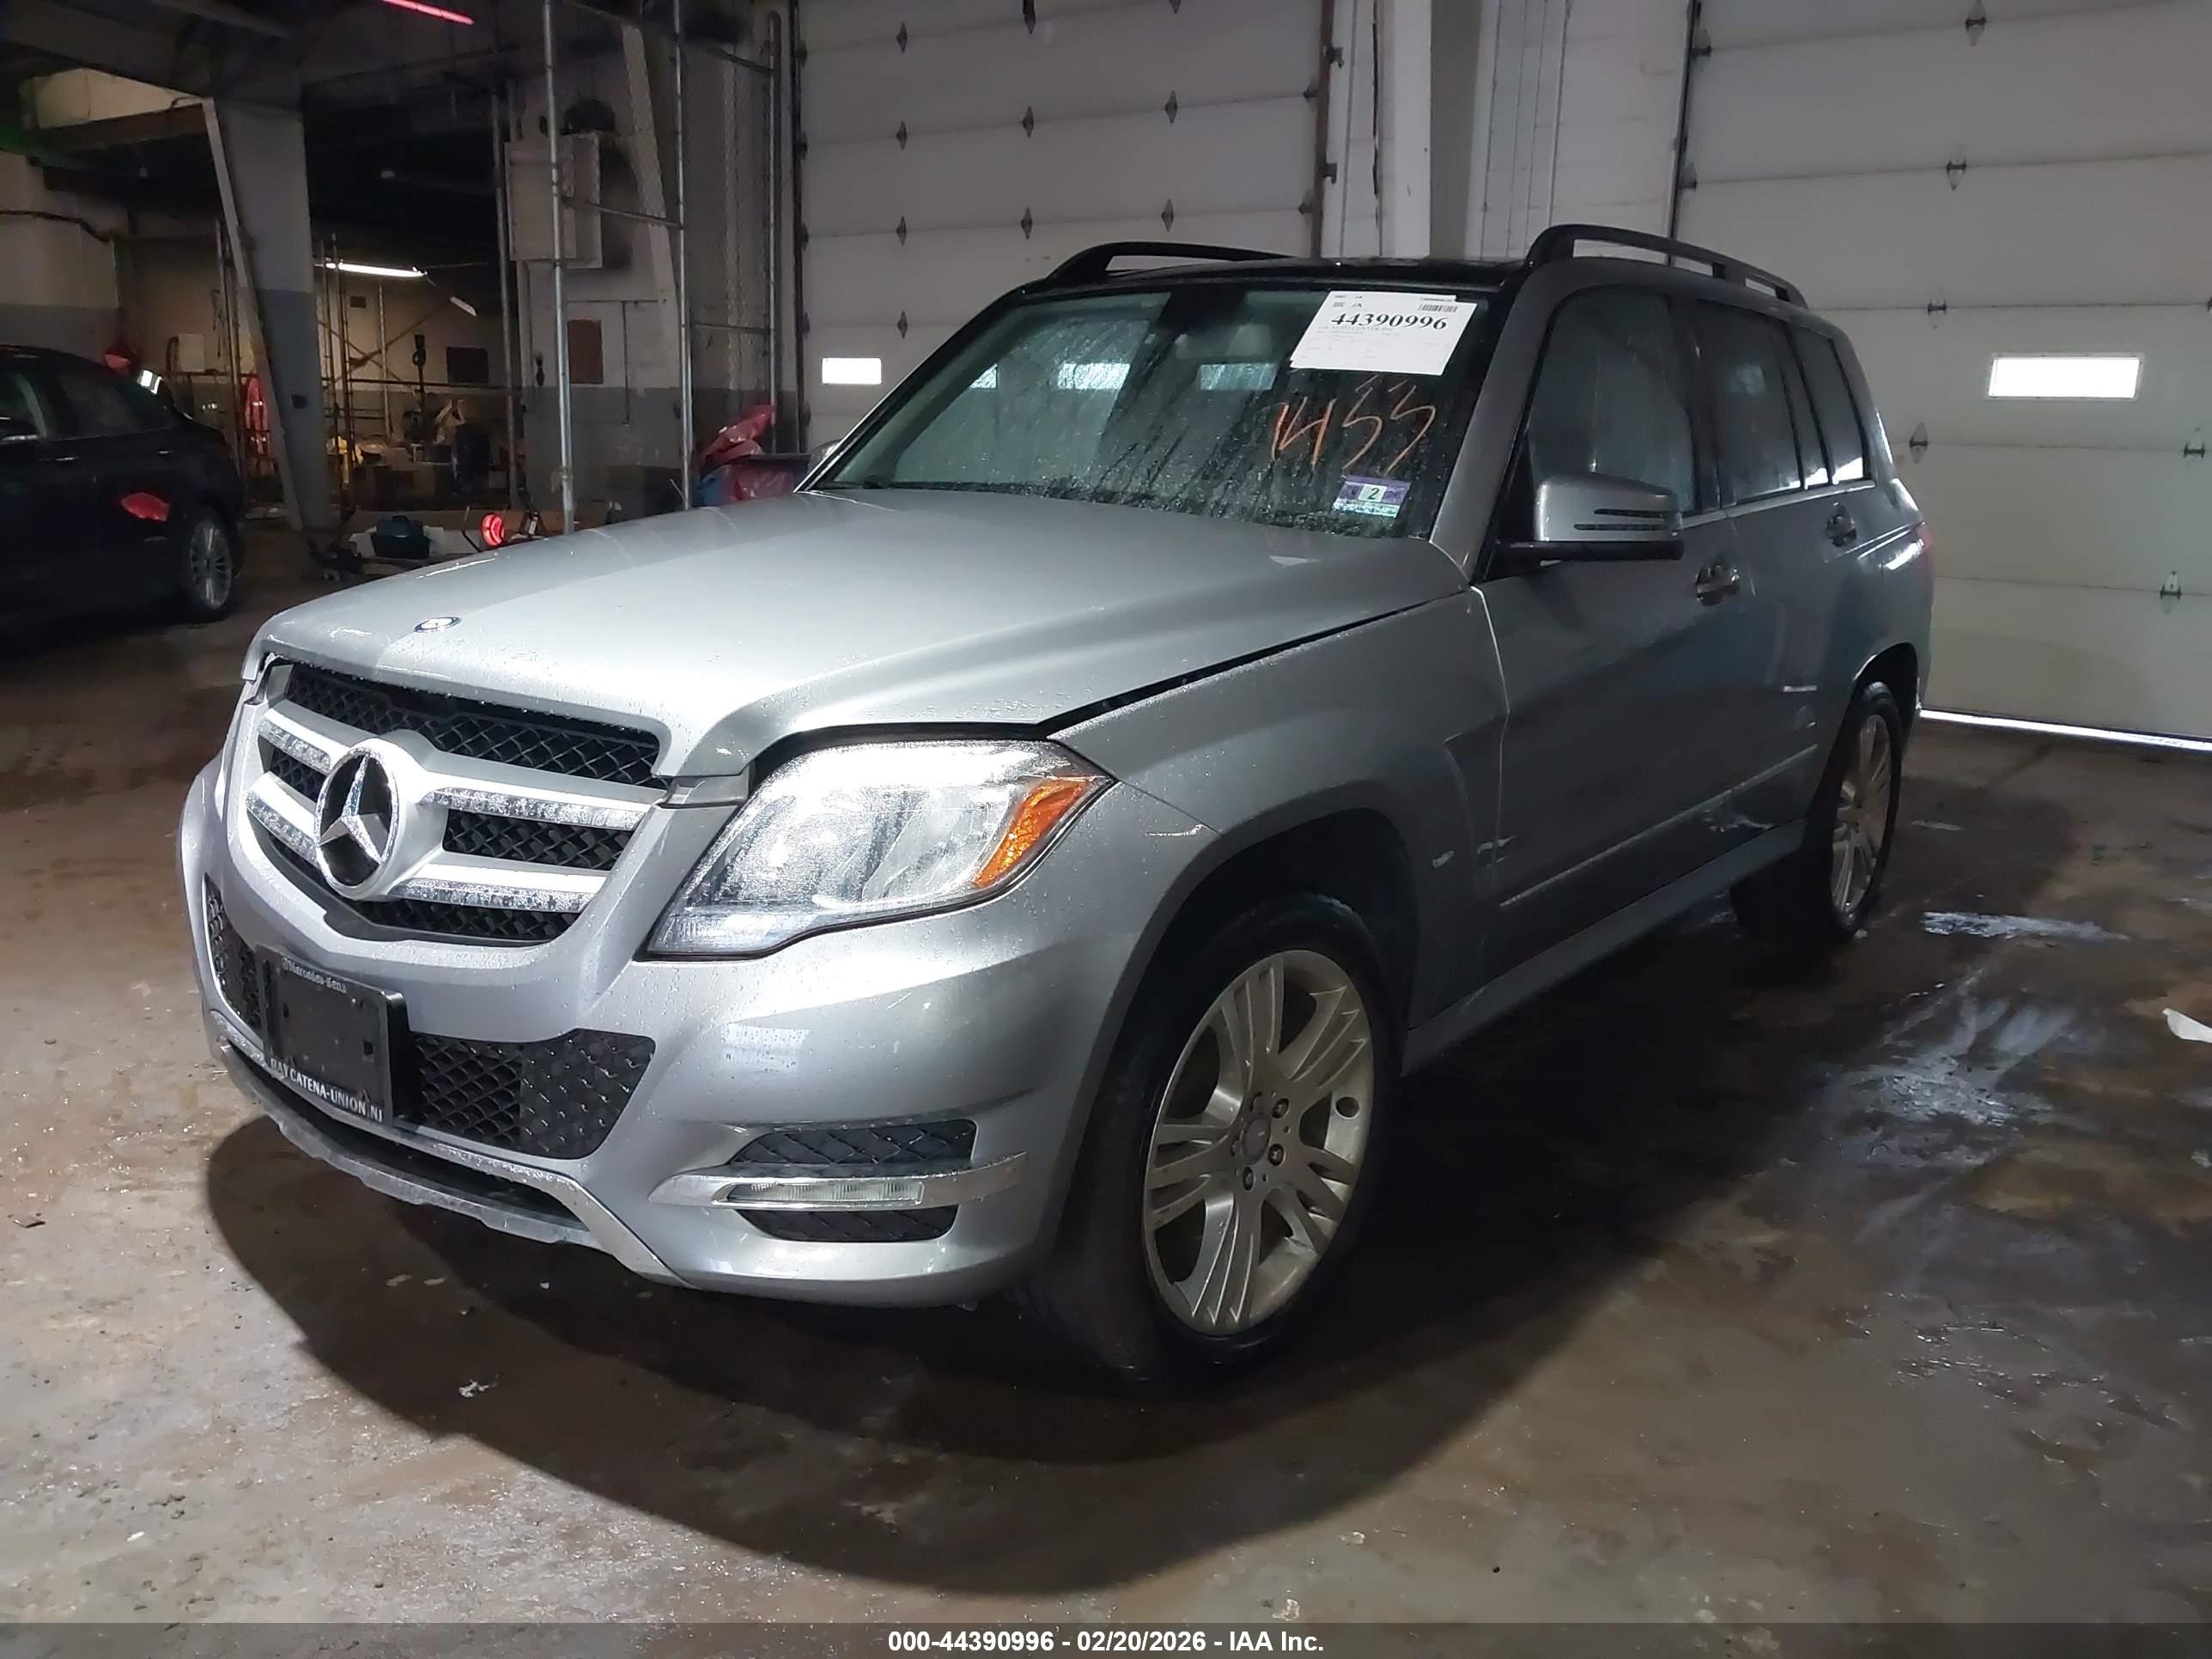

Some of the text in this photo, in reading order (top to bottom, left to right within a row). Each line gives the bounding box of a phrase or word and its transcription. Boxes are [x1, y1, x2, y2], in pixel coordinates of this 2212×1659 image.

[1332, 313, 1449, 331] 44390996
[1367, 487, 1380, 500] 2
[270, 1057, 289, 1078] RAY
[370, 1104, 383, 1122] NJ
